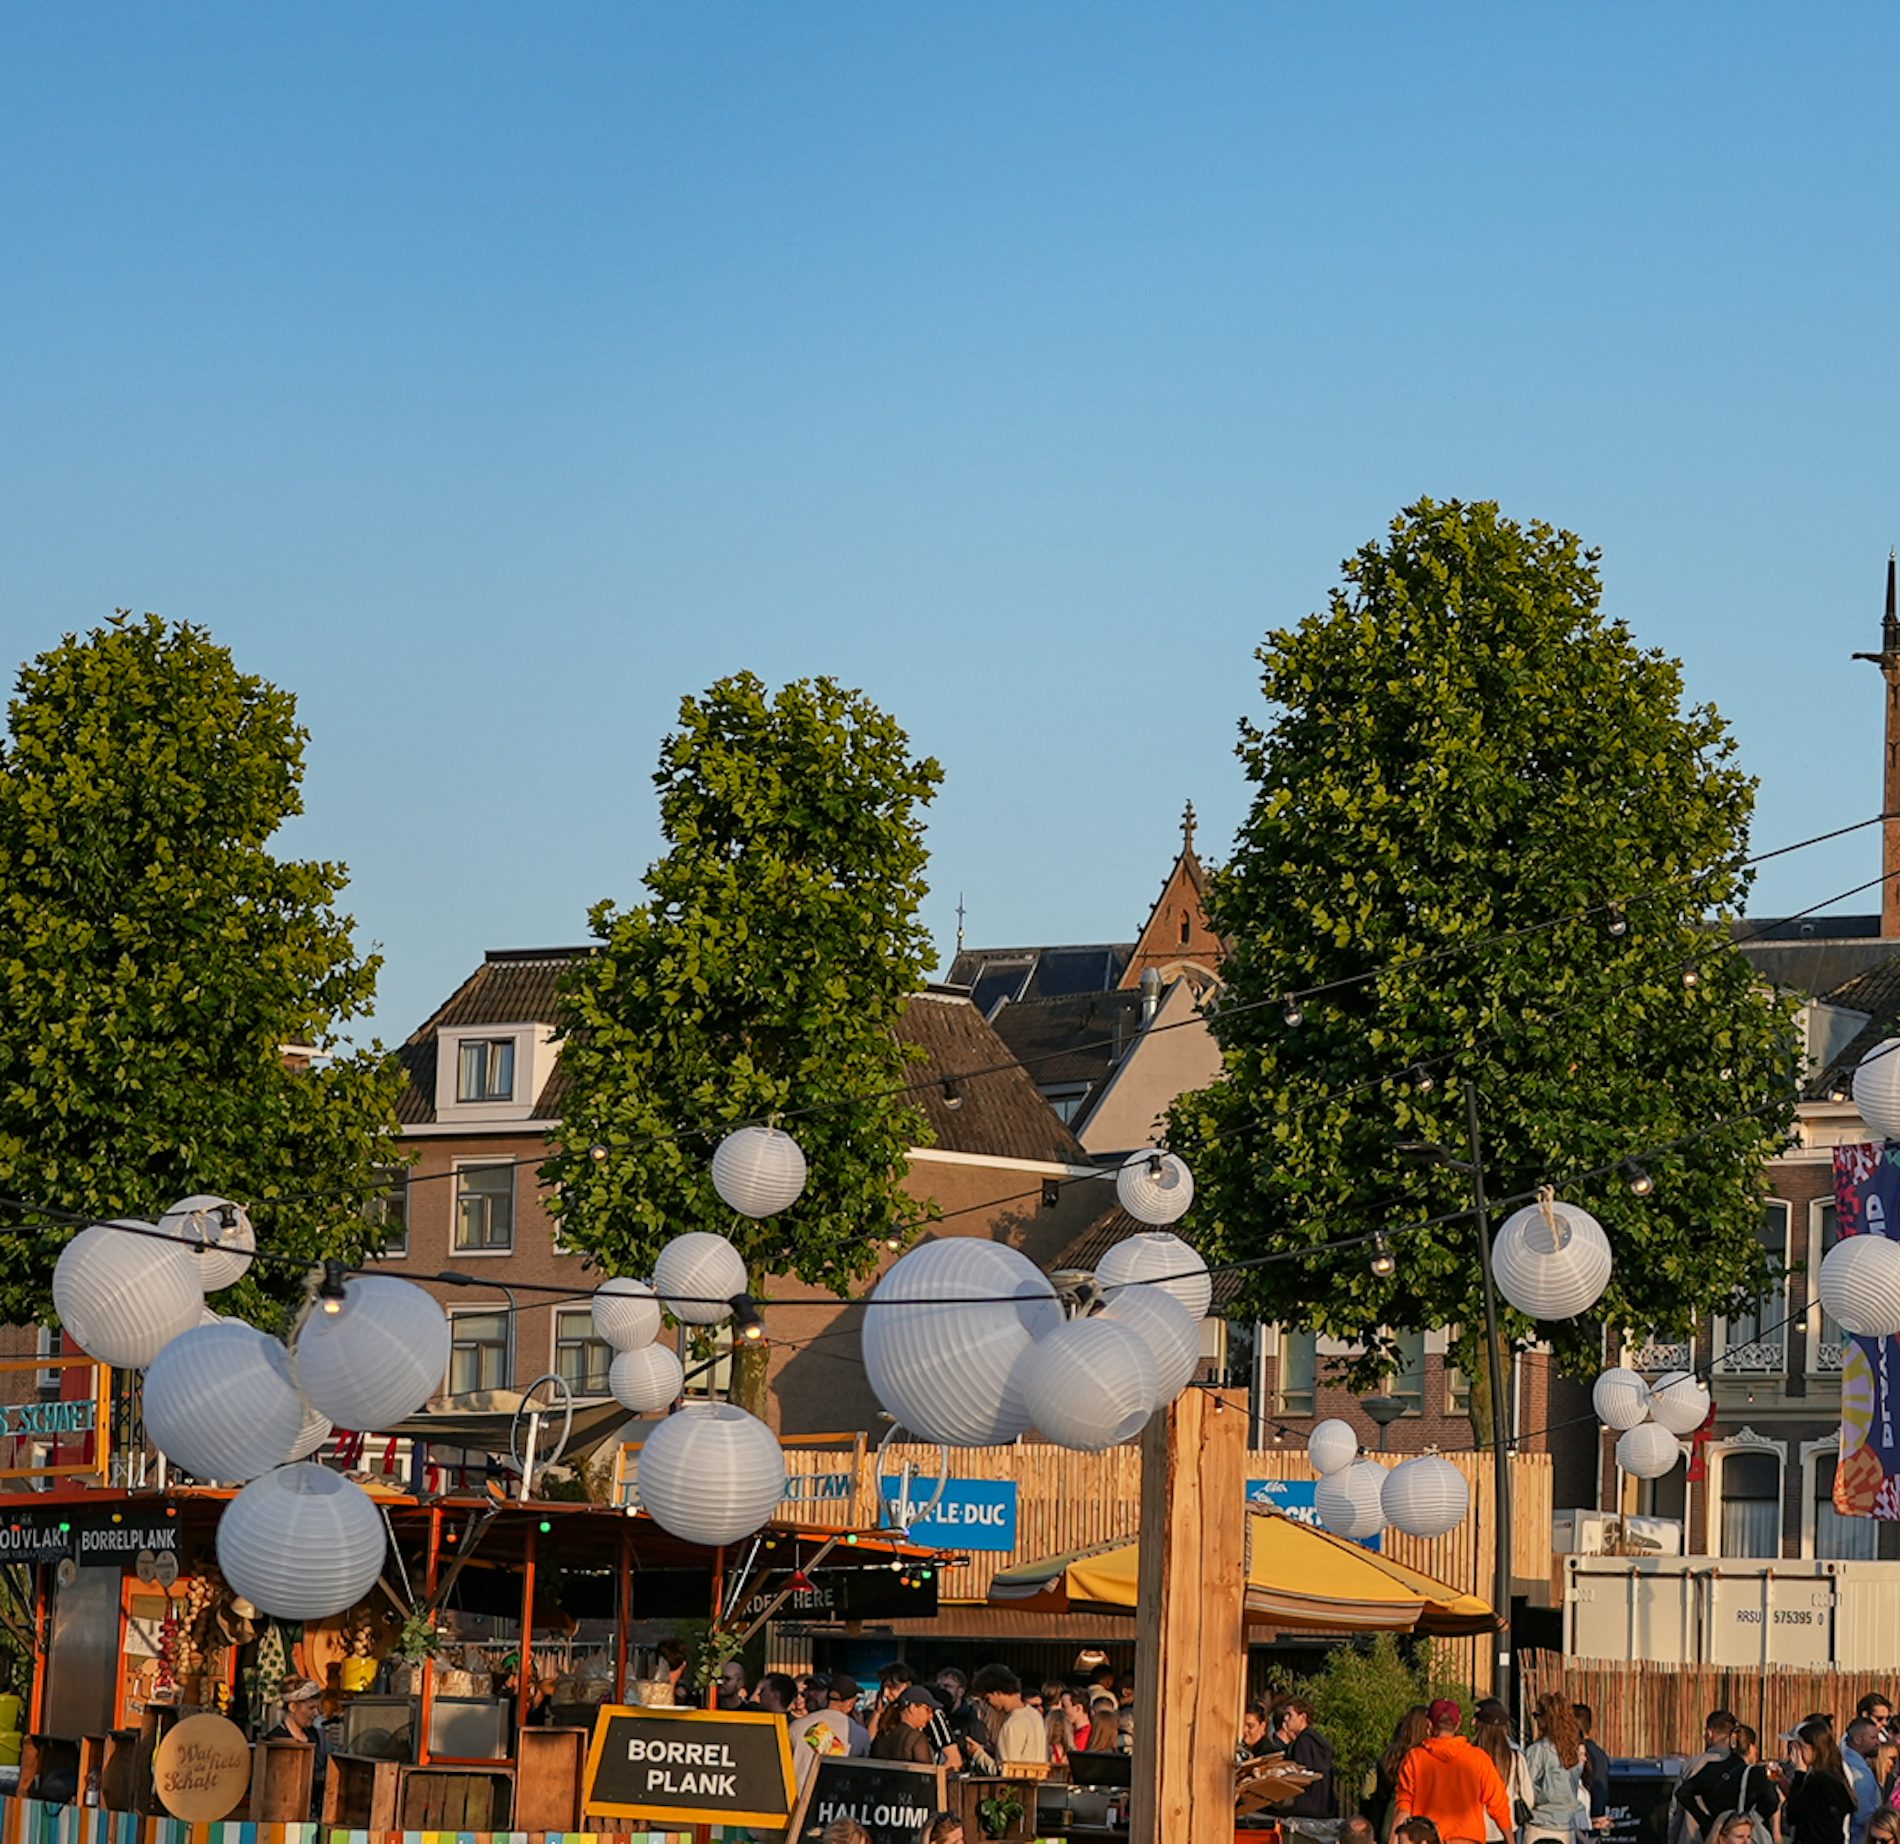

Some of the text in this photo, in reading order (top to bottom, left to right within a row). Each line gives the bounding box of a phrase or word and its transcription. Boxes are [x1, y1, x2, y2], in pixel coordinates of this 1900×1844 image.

[82, 1527, 176, 1551] BORRELPLANK
[793, 1587, 835, 1609] HERE
[1773, 1610, 1813, 1625] 575395
[627, 1738, 737, 1768] BORREL
[646, 1769, 738, 1797] PLANK
